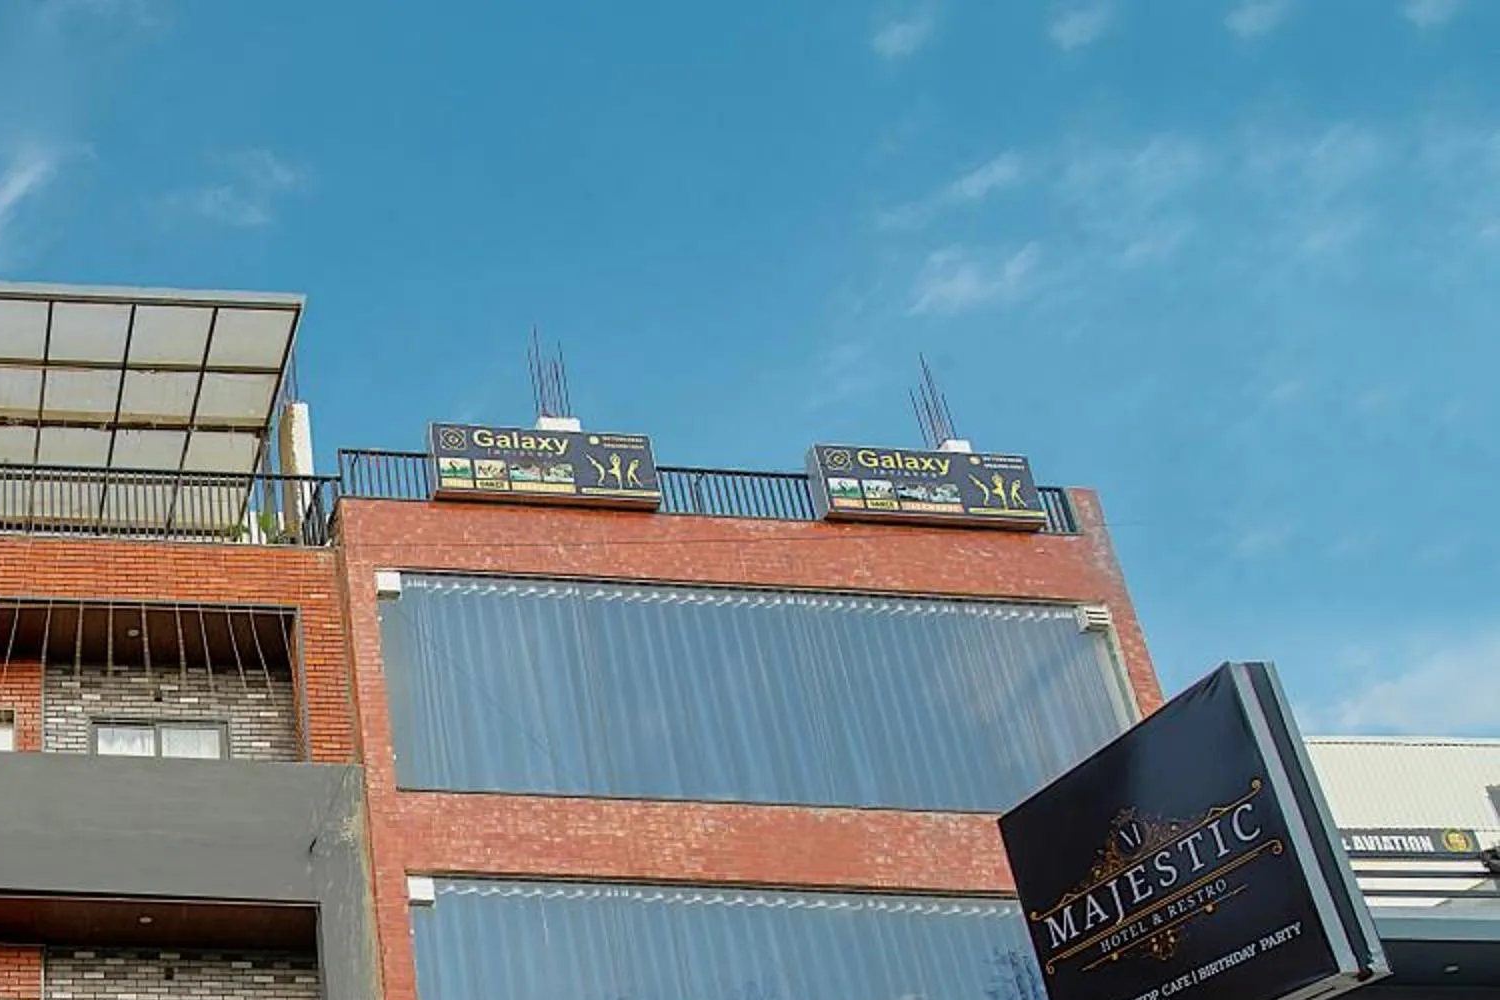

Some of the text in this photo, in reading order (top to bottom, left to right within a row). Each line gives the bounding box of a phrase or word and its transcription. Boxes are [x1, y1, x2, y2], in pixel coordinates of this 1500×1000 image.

[472, 429, 569, 455] Galaxy
[857, 450, 950, 475] Galaxy
[1351, 835, 1435, 853] AVIATION
[1043, 803, 1261, 949] MAJESTIC
[1100, 878, 1227, 953] HOTEL & RESTRO
[1161, 974, 1193, 997] CAFE
[1198, 944, 1258, 981] BIRTHDAY
[1259, 922, 1303, 951] PARTY
